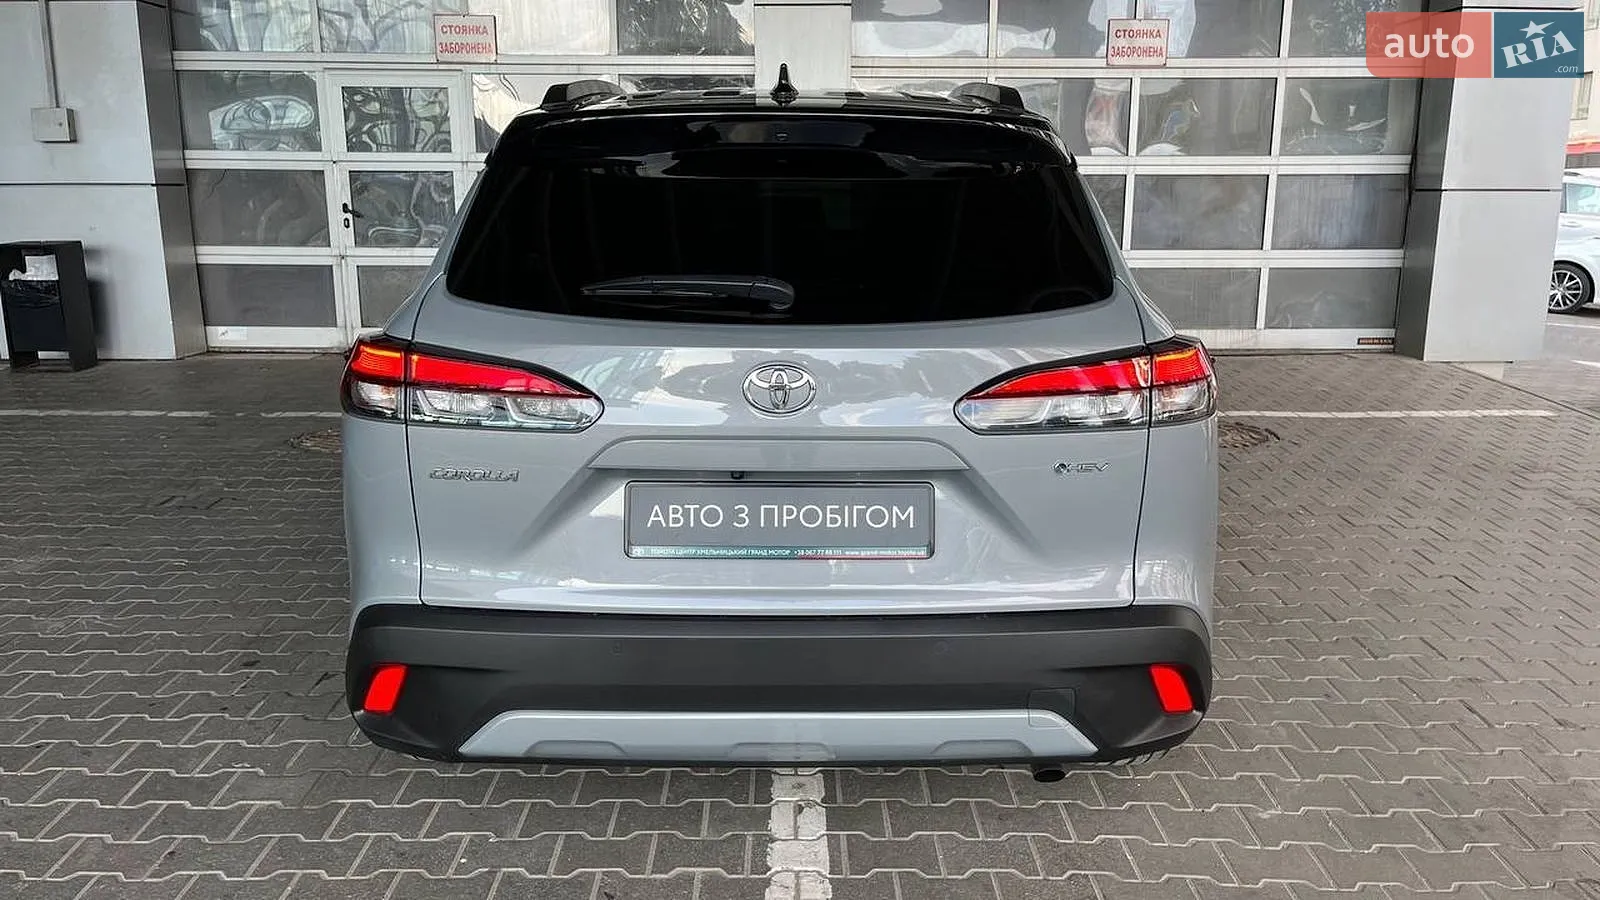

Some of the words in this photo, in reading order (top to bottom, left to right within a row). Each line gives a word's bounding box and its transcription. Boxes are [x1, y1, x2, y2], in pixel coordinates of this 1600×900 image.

[440, 24, 488, 35] СТОЯНКА
[1115, 29, 1162, 39] СТОЯНКА
[439, 42, 493, 54] ЗАБОРОНЕНА
[1111, 46, 1164, 58] ЗАБОРОНЕНА
[429, 467, 520, 481] COROLLA
[647, 504, 724, 528] АВТО
[732, 504, 750, 528] З
[760, 504, 915, 529] ПРОБІГОМ
